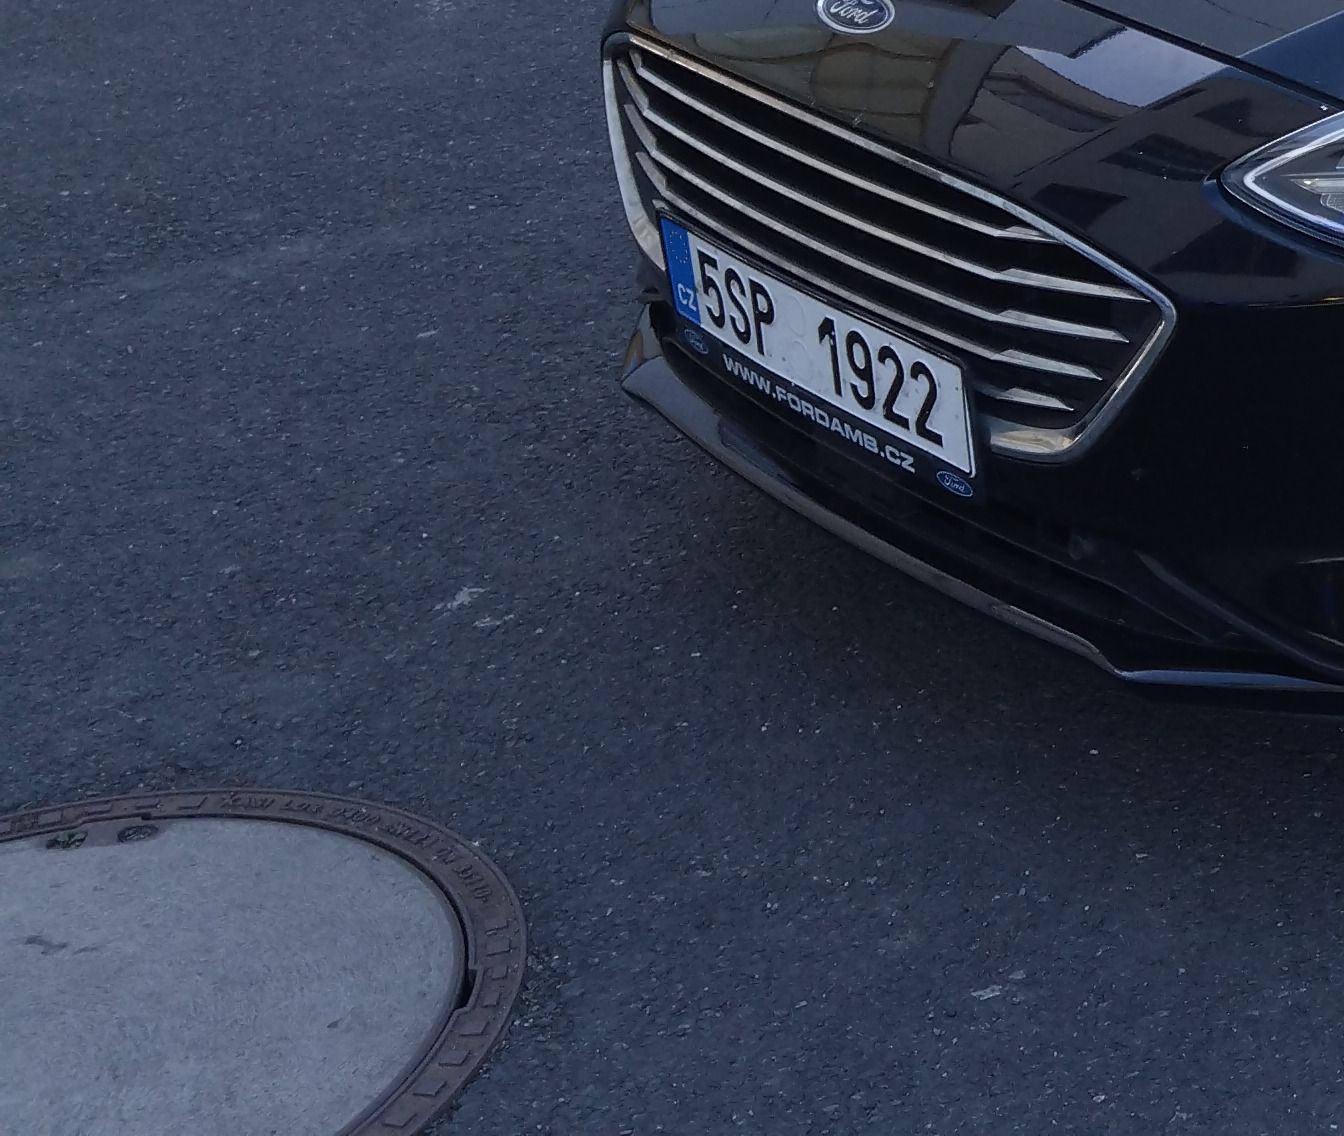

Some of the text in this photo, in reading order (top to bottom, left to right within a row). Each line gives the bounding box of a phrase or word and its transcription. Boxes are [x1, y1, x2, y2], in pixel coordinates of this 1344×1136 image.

[676, 282, 697, 312] CZ
[697, 248, 944, 448] 5SP 1922
[722, 353, 916, 473] WWW.FORDAMB.CZ
